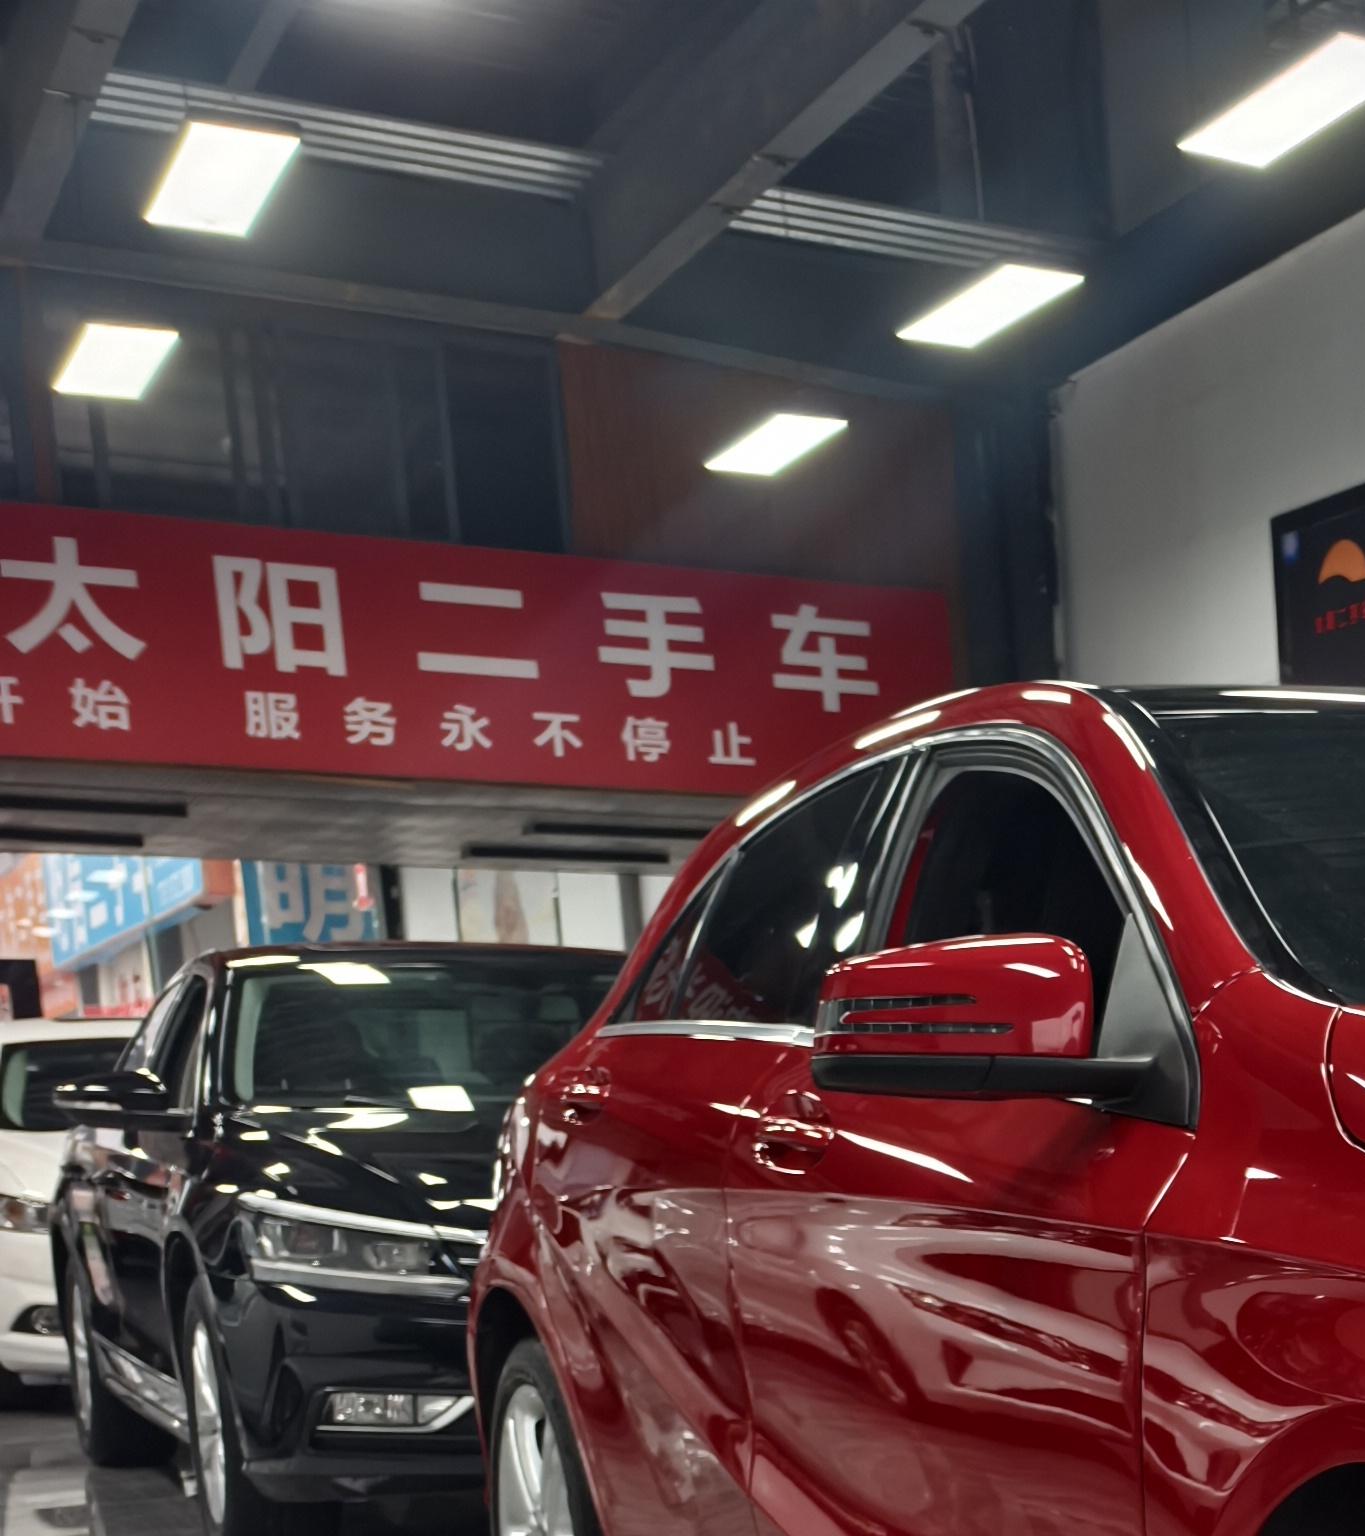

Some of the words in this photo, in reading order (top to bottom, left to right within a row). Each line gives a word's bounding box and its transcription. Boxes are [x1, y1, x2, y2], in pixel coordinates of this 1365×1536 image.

[0, 536, 880, 713] 太阳二手车
[245, 690, 757, 768] 服务永不停止
